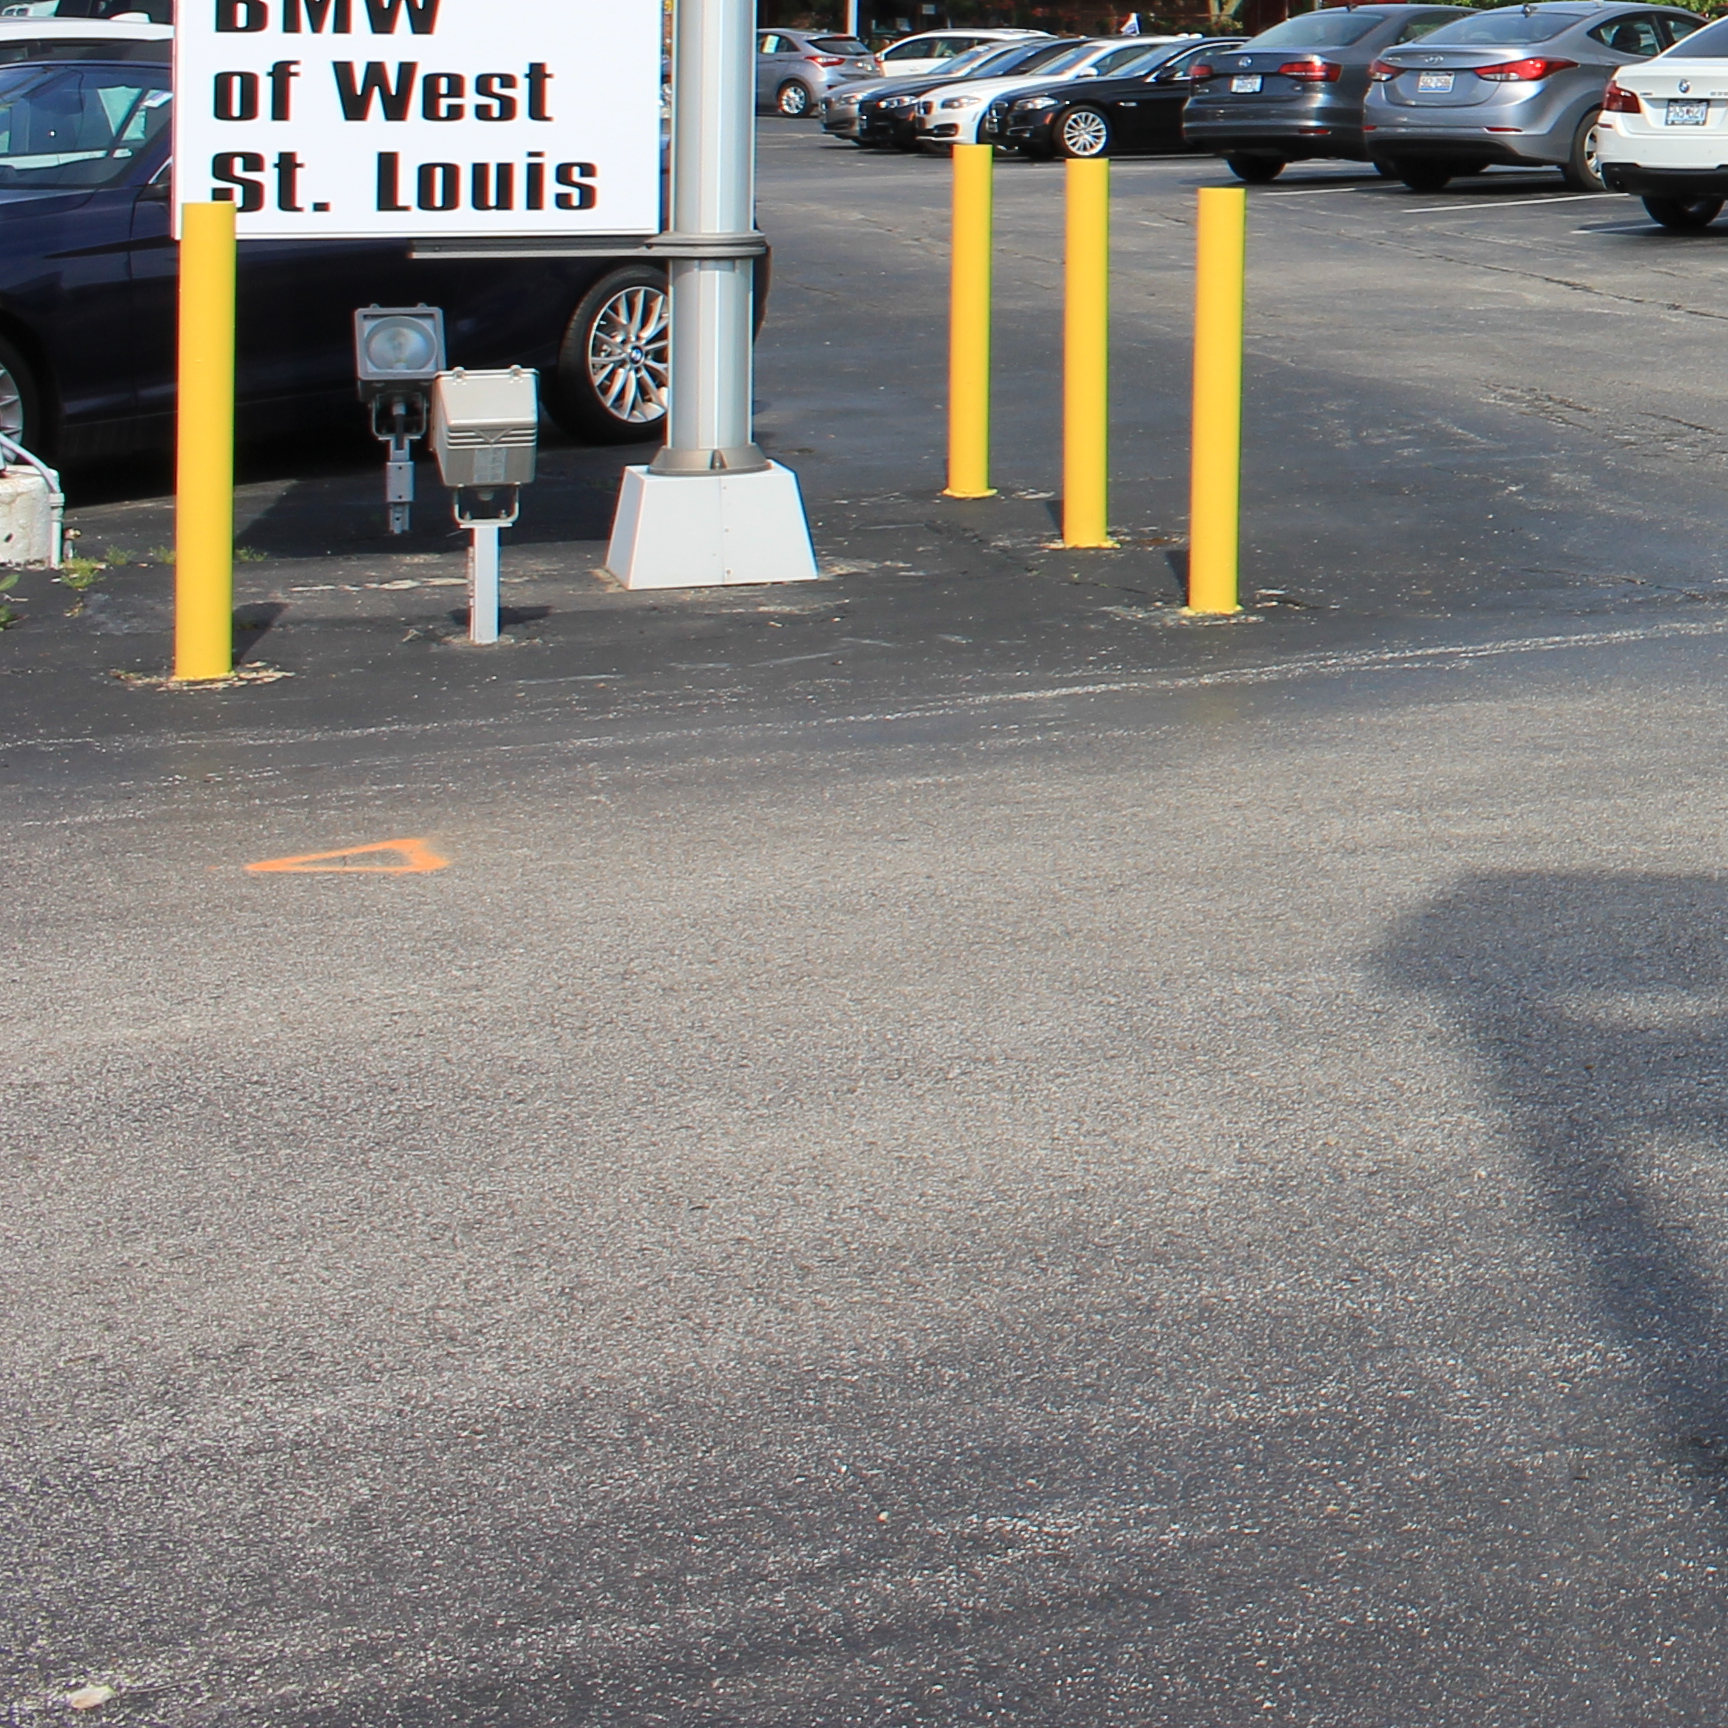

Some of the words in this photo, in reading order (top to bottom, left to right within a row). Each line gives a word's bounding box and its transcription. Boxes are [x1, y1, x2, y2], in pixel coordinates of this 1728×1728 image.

[212, 60, 302, 122] of
[331, 61, 555, 122] West
[211, 151, 331, 213] St.
[376, 151, 598, 213] Louis
